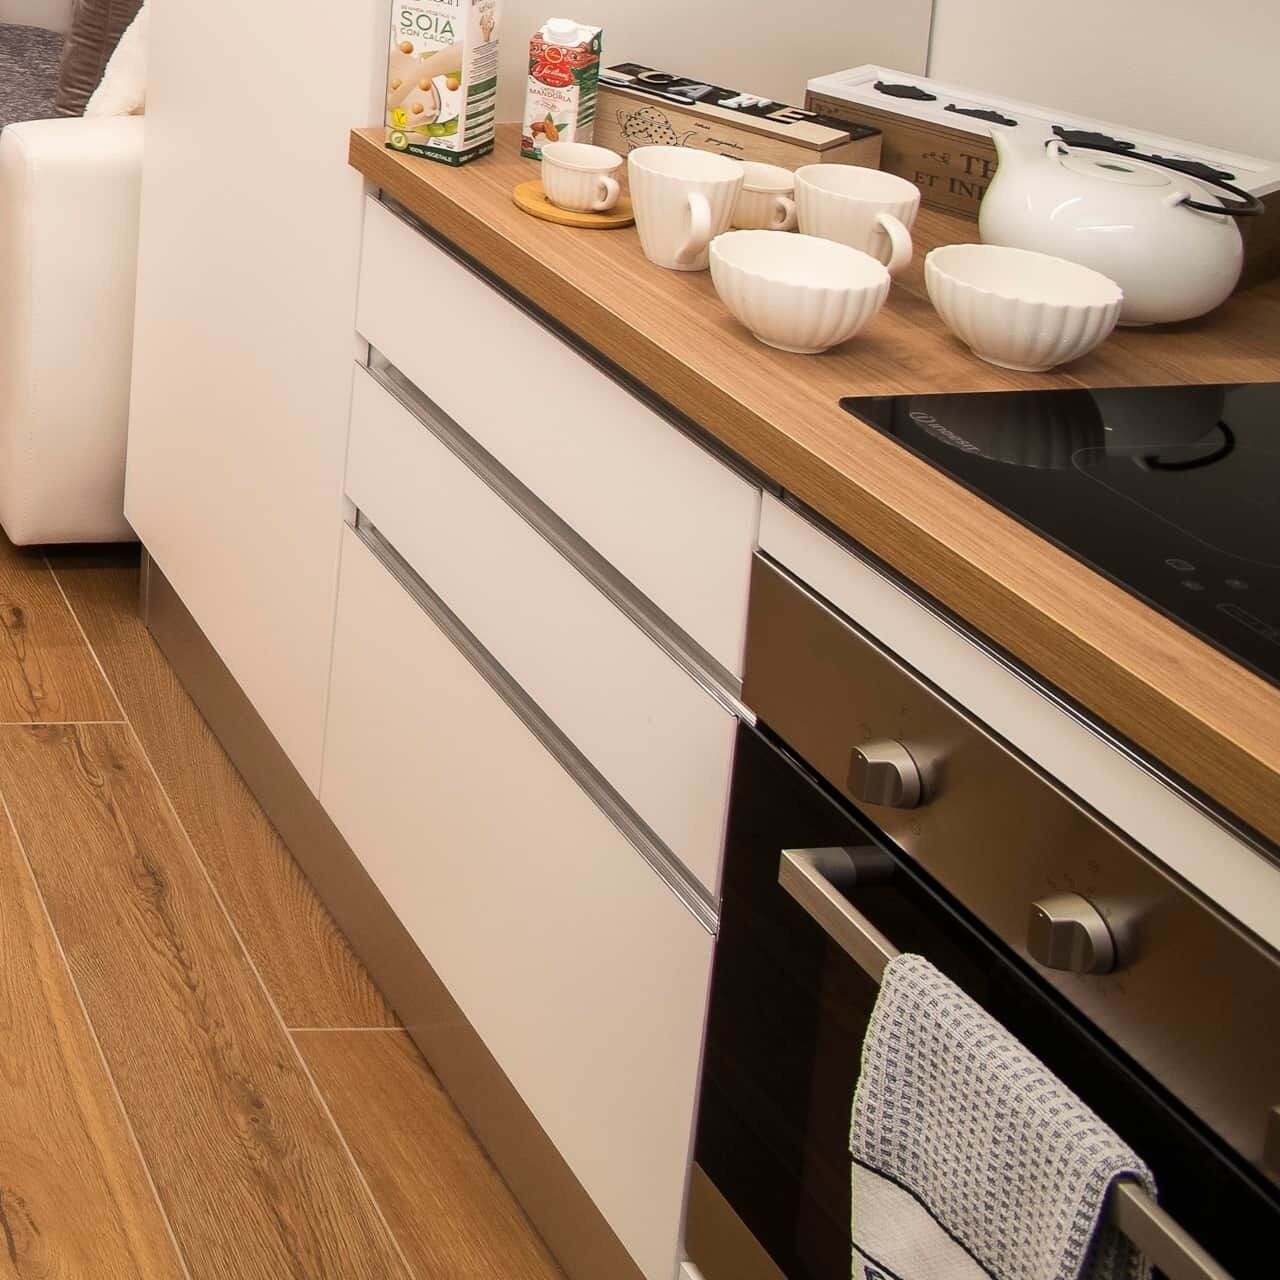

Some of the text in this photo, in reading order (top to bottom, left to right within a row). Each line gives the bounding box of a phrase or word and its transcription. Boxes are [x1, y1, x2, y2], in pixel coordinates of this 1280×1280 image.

[400, 10, 455, 37] SOIA
[400, 27, 454, 45] CON CALCIO
[528, 87, 572, 103] MANDORLA
[913, 171, 939, 187] ET
